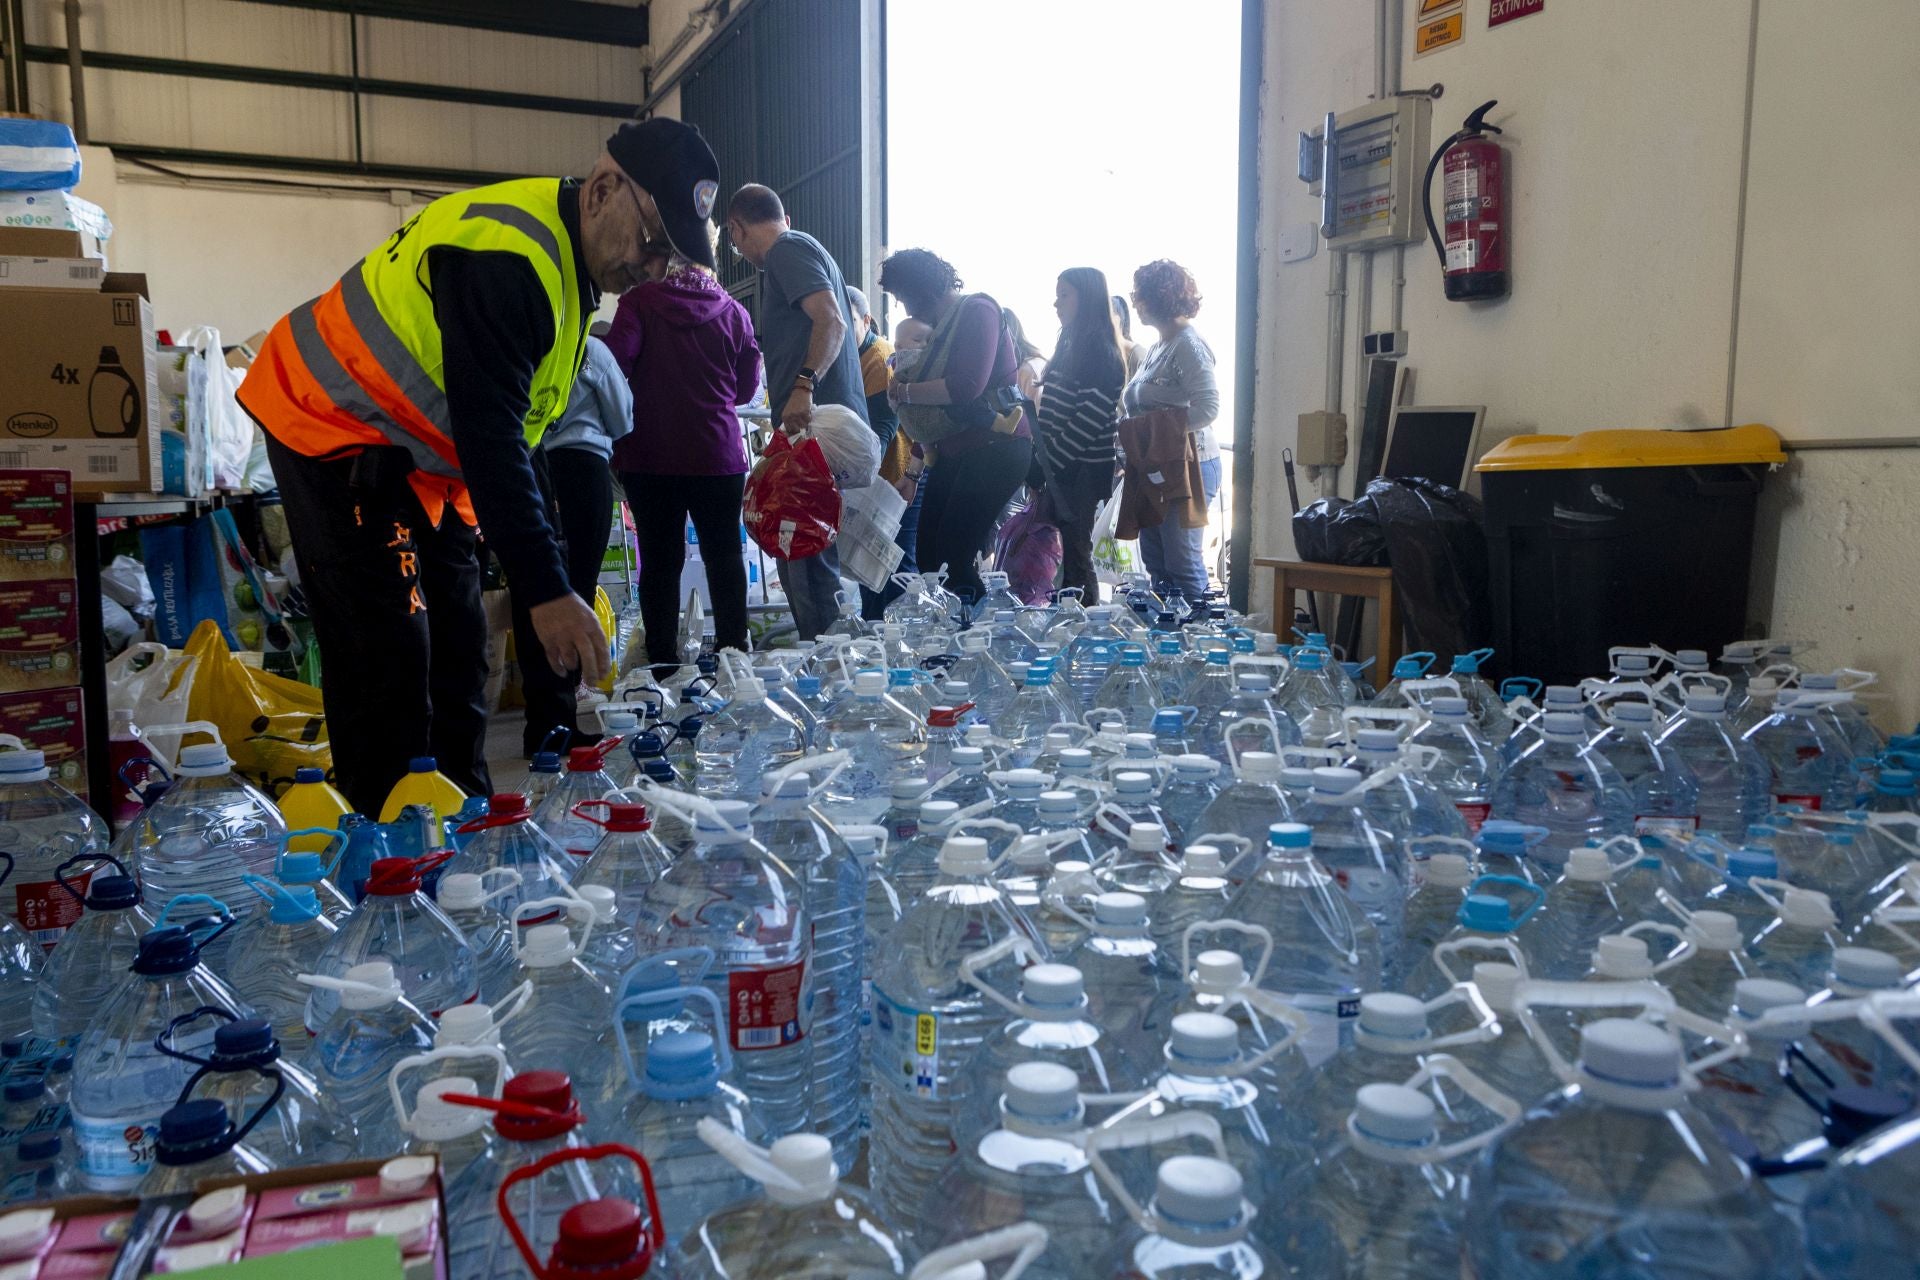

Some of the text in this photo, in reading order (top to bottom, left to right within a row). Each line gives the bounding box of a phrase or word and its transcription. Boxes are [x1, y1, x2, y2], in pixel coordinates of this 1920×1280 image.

[1429, 22, 1448, 34] RIESGO
[51, 363, 80, 385] 4x
[12, 420, 54, 430] Henkel
